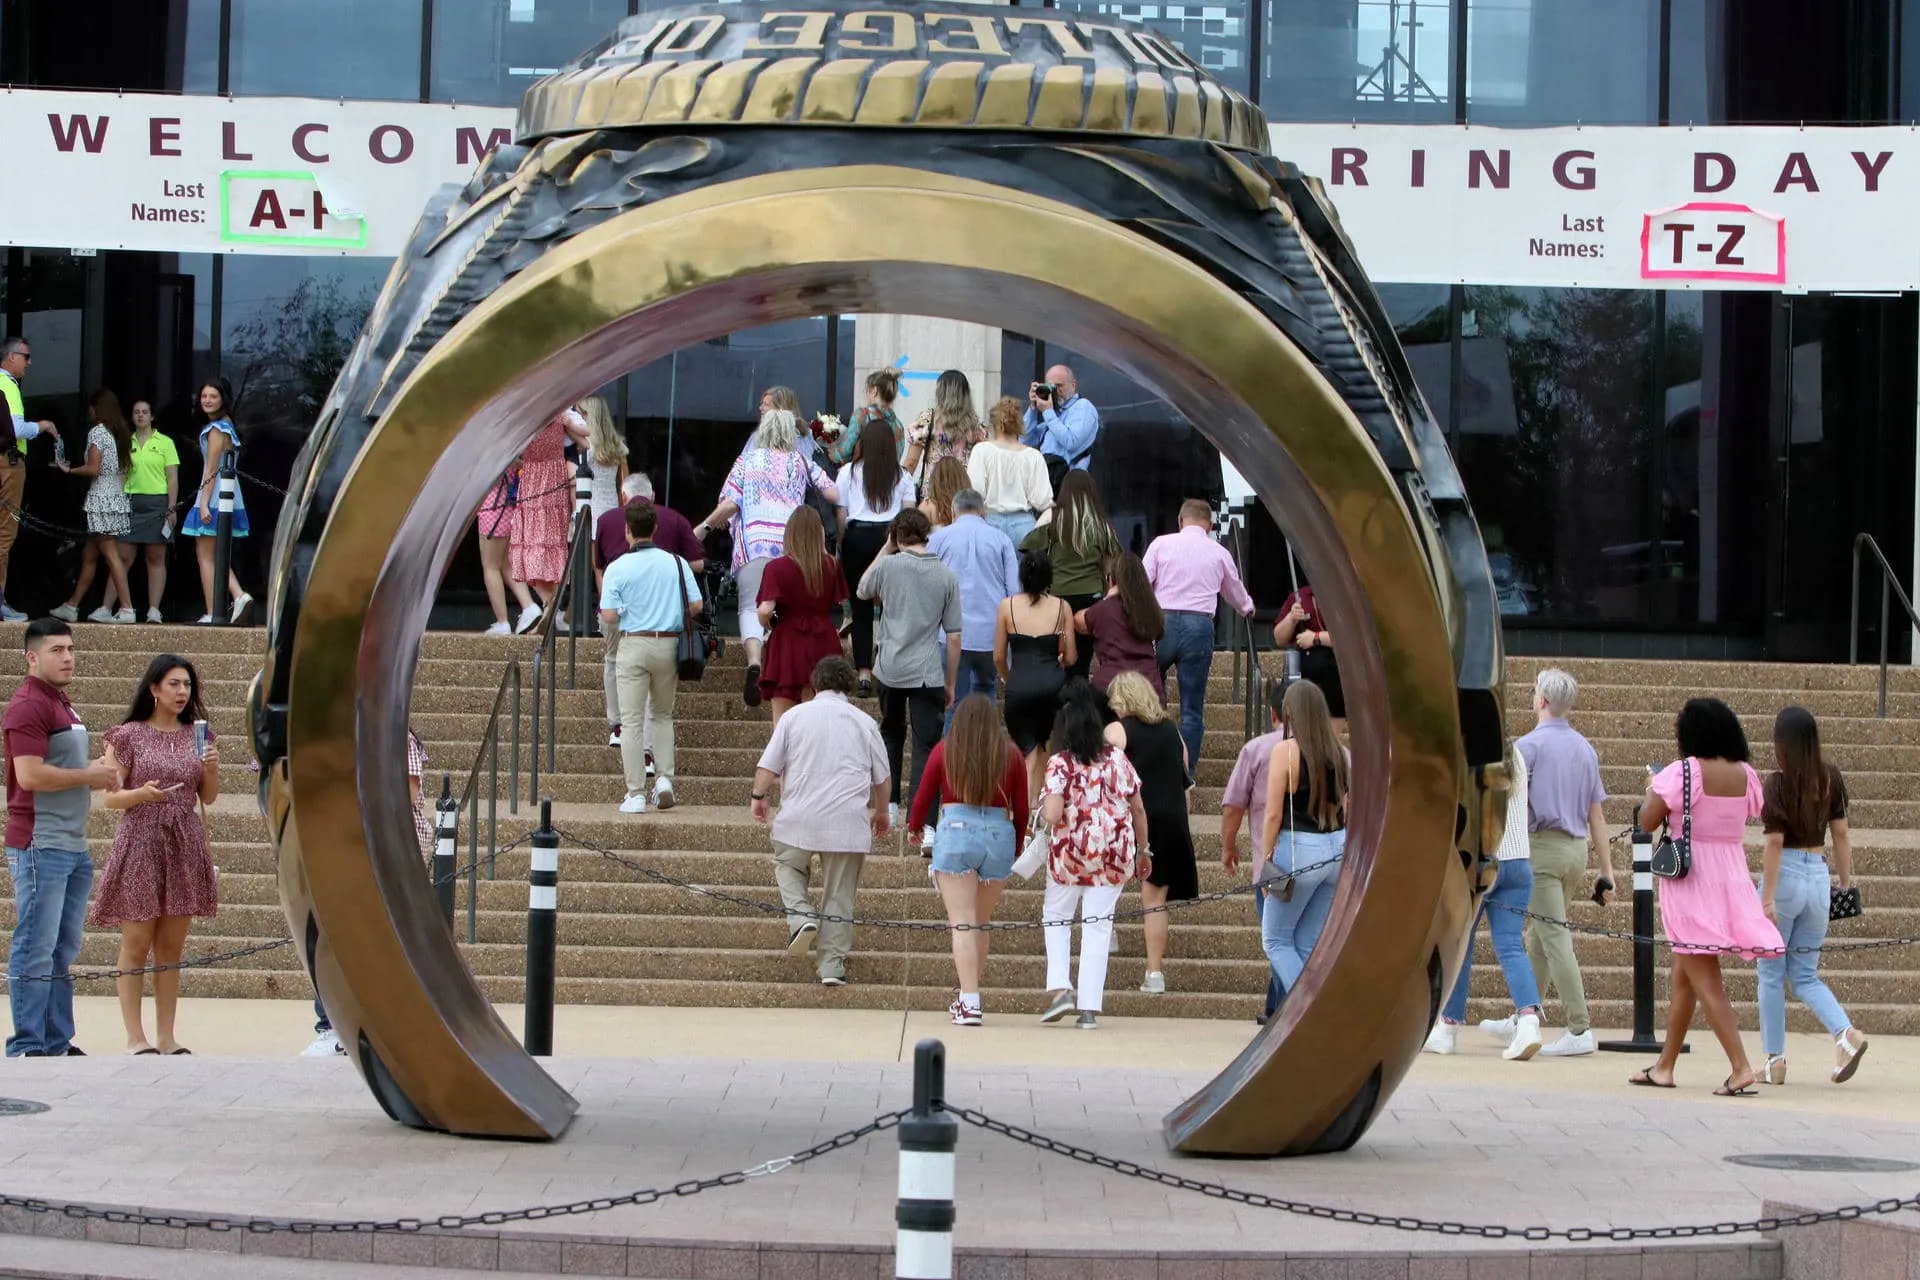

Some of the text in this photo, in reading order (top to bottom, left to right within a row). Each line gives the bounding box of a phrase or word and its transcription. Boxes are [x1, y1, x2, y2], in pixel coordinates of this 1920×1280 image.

[744, 10, 1198, 74] OLLEGE
[47, 113, 512, 165] WELCOM
[1330, 147, 1894, 194] RING DAY
[163, 179, 205, 199] Last
[131, 203, 205, 224] Names:
[1562, 213, 1605, 233] Last
[1529, 238, 1604, 258] Names:
[1663, 223, 1746, 266] T-Z
